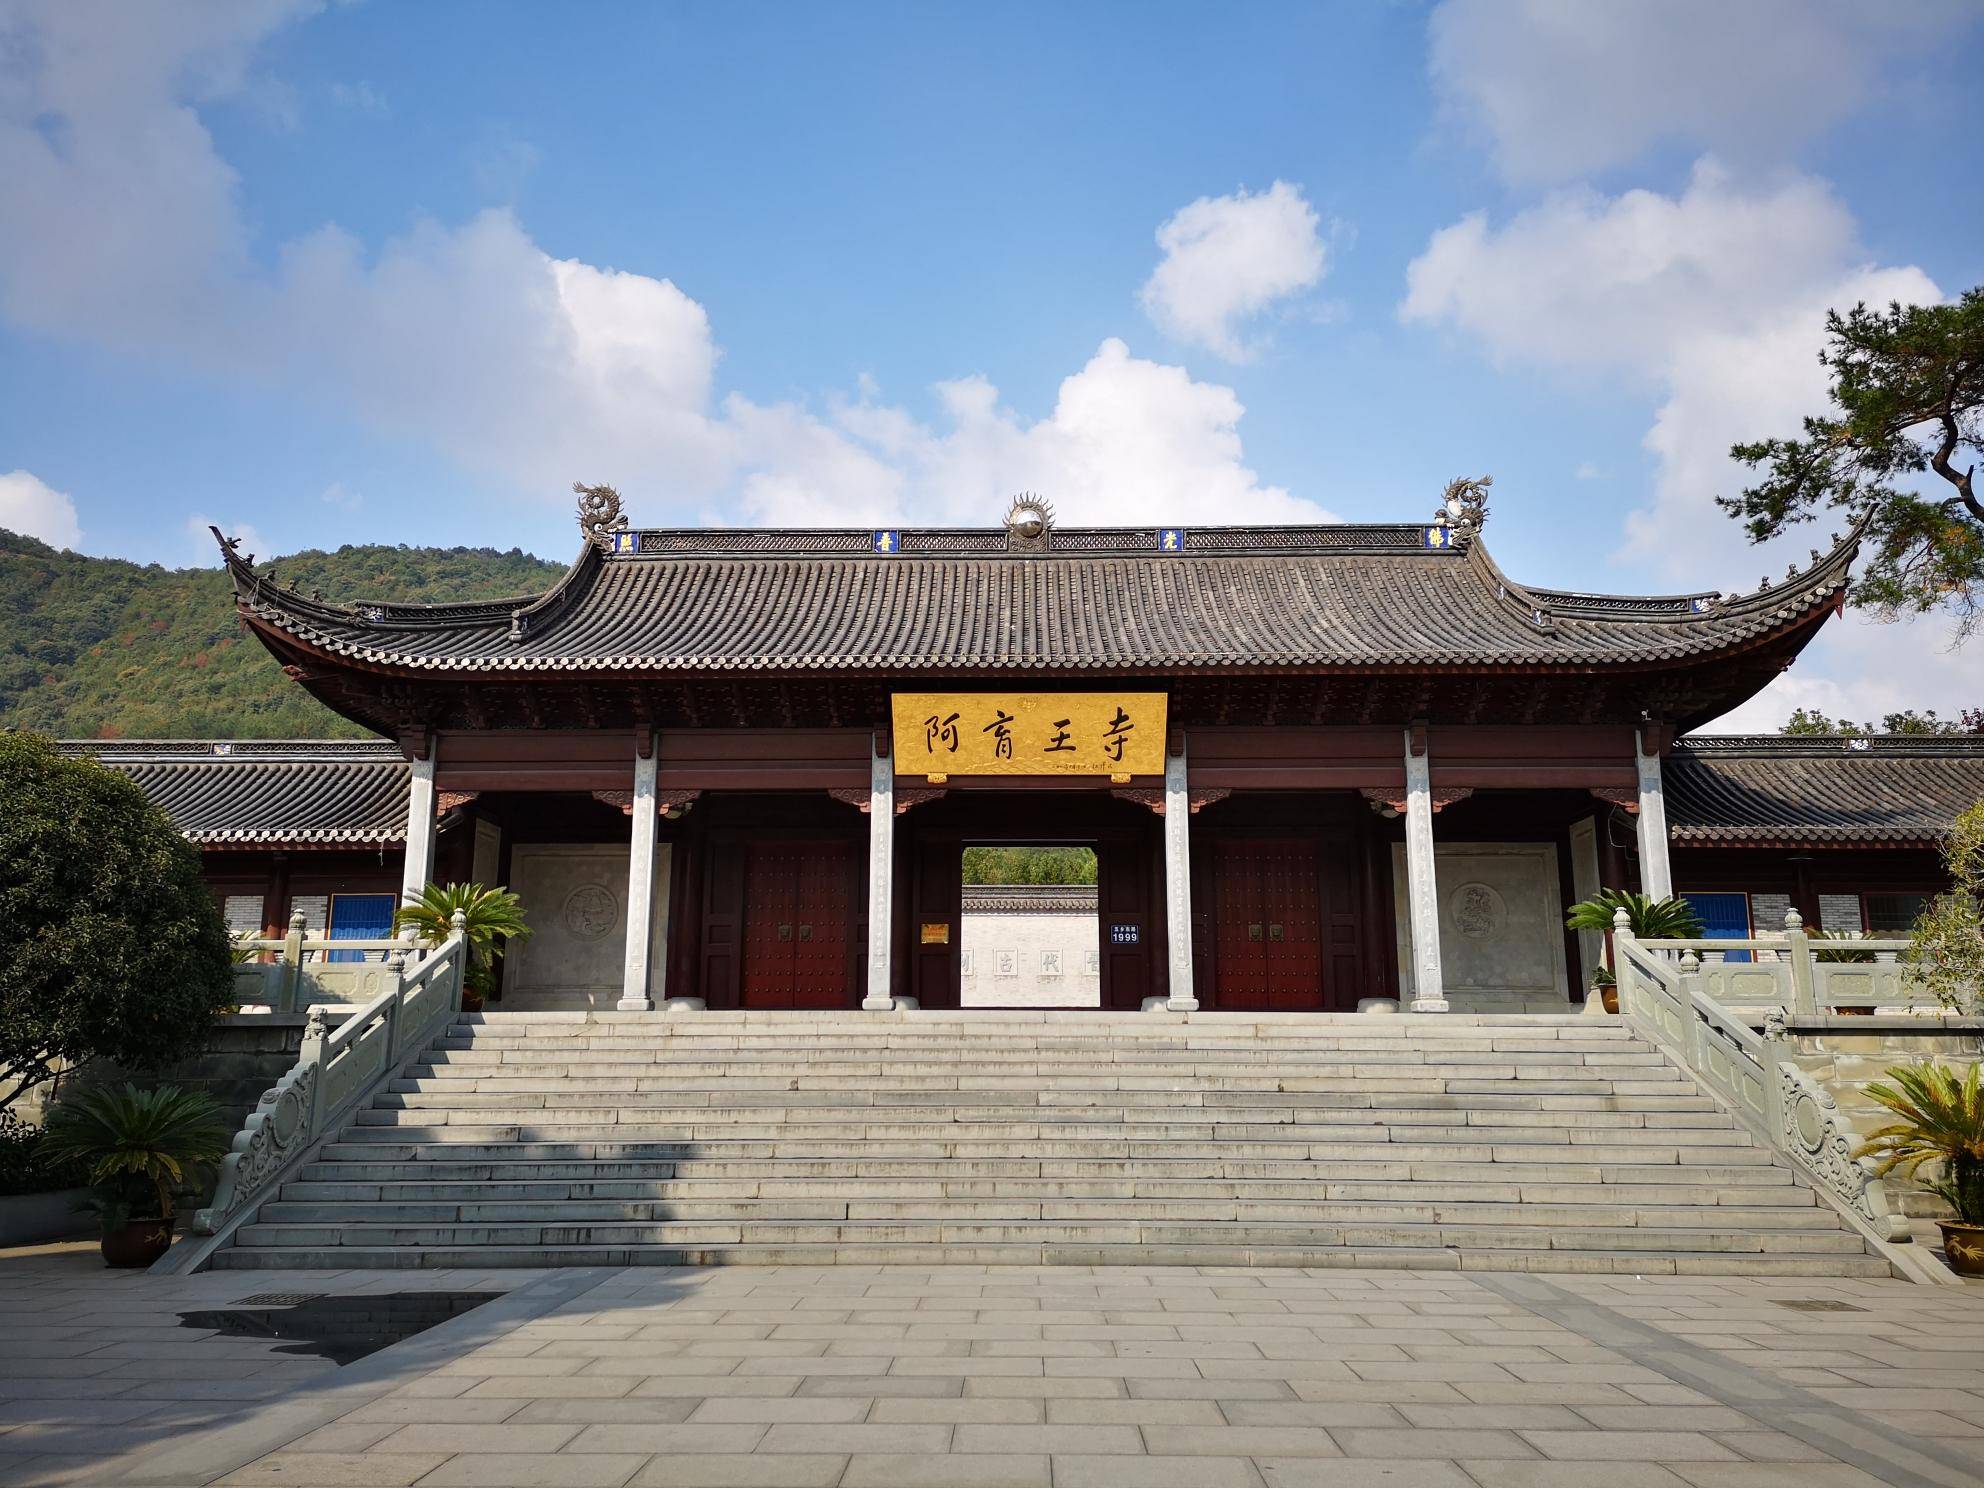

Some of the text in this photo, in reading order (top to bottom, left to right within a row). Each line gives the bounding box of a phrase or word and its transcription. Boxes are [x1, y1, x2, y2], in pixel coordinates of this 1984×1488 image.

[1164, 531, 1177, 549] 光
[924, 706, 1134, 761] 阿育王寺
[1113, 933, 1137, 942] 1999
